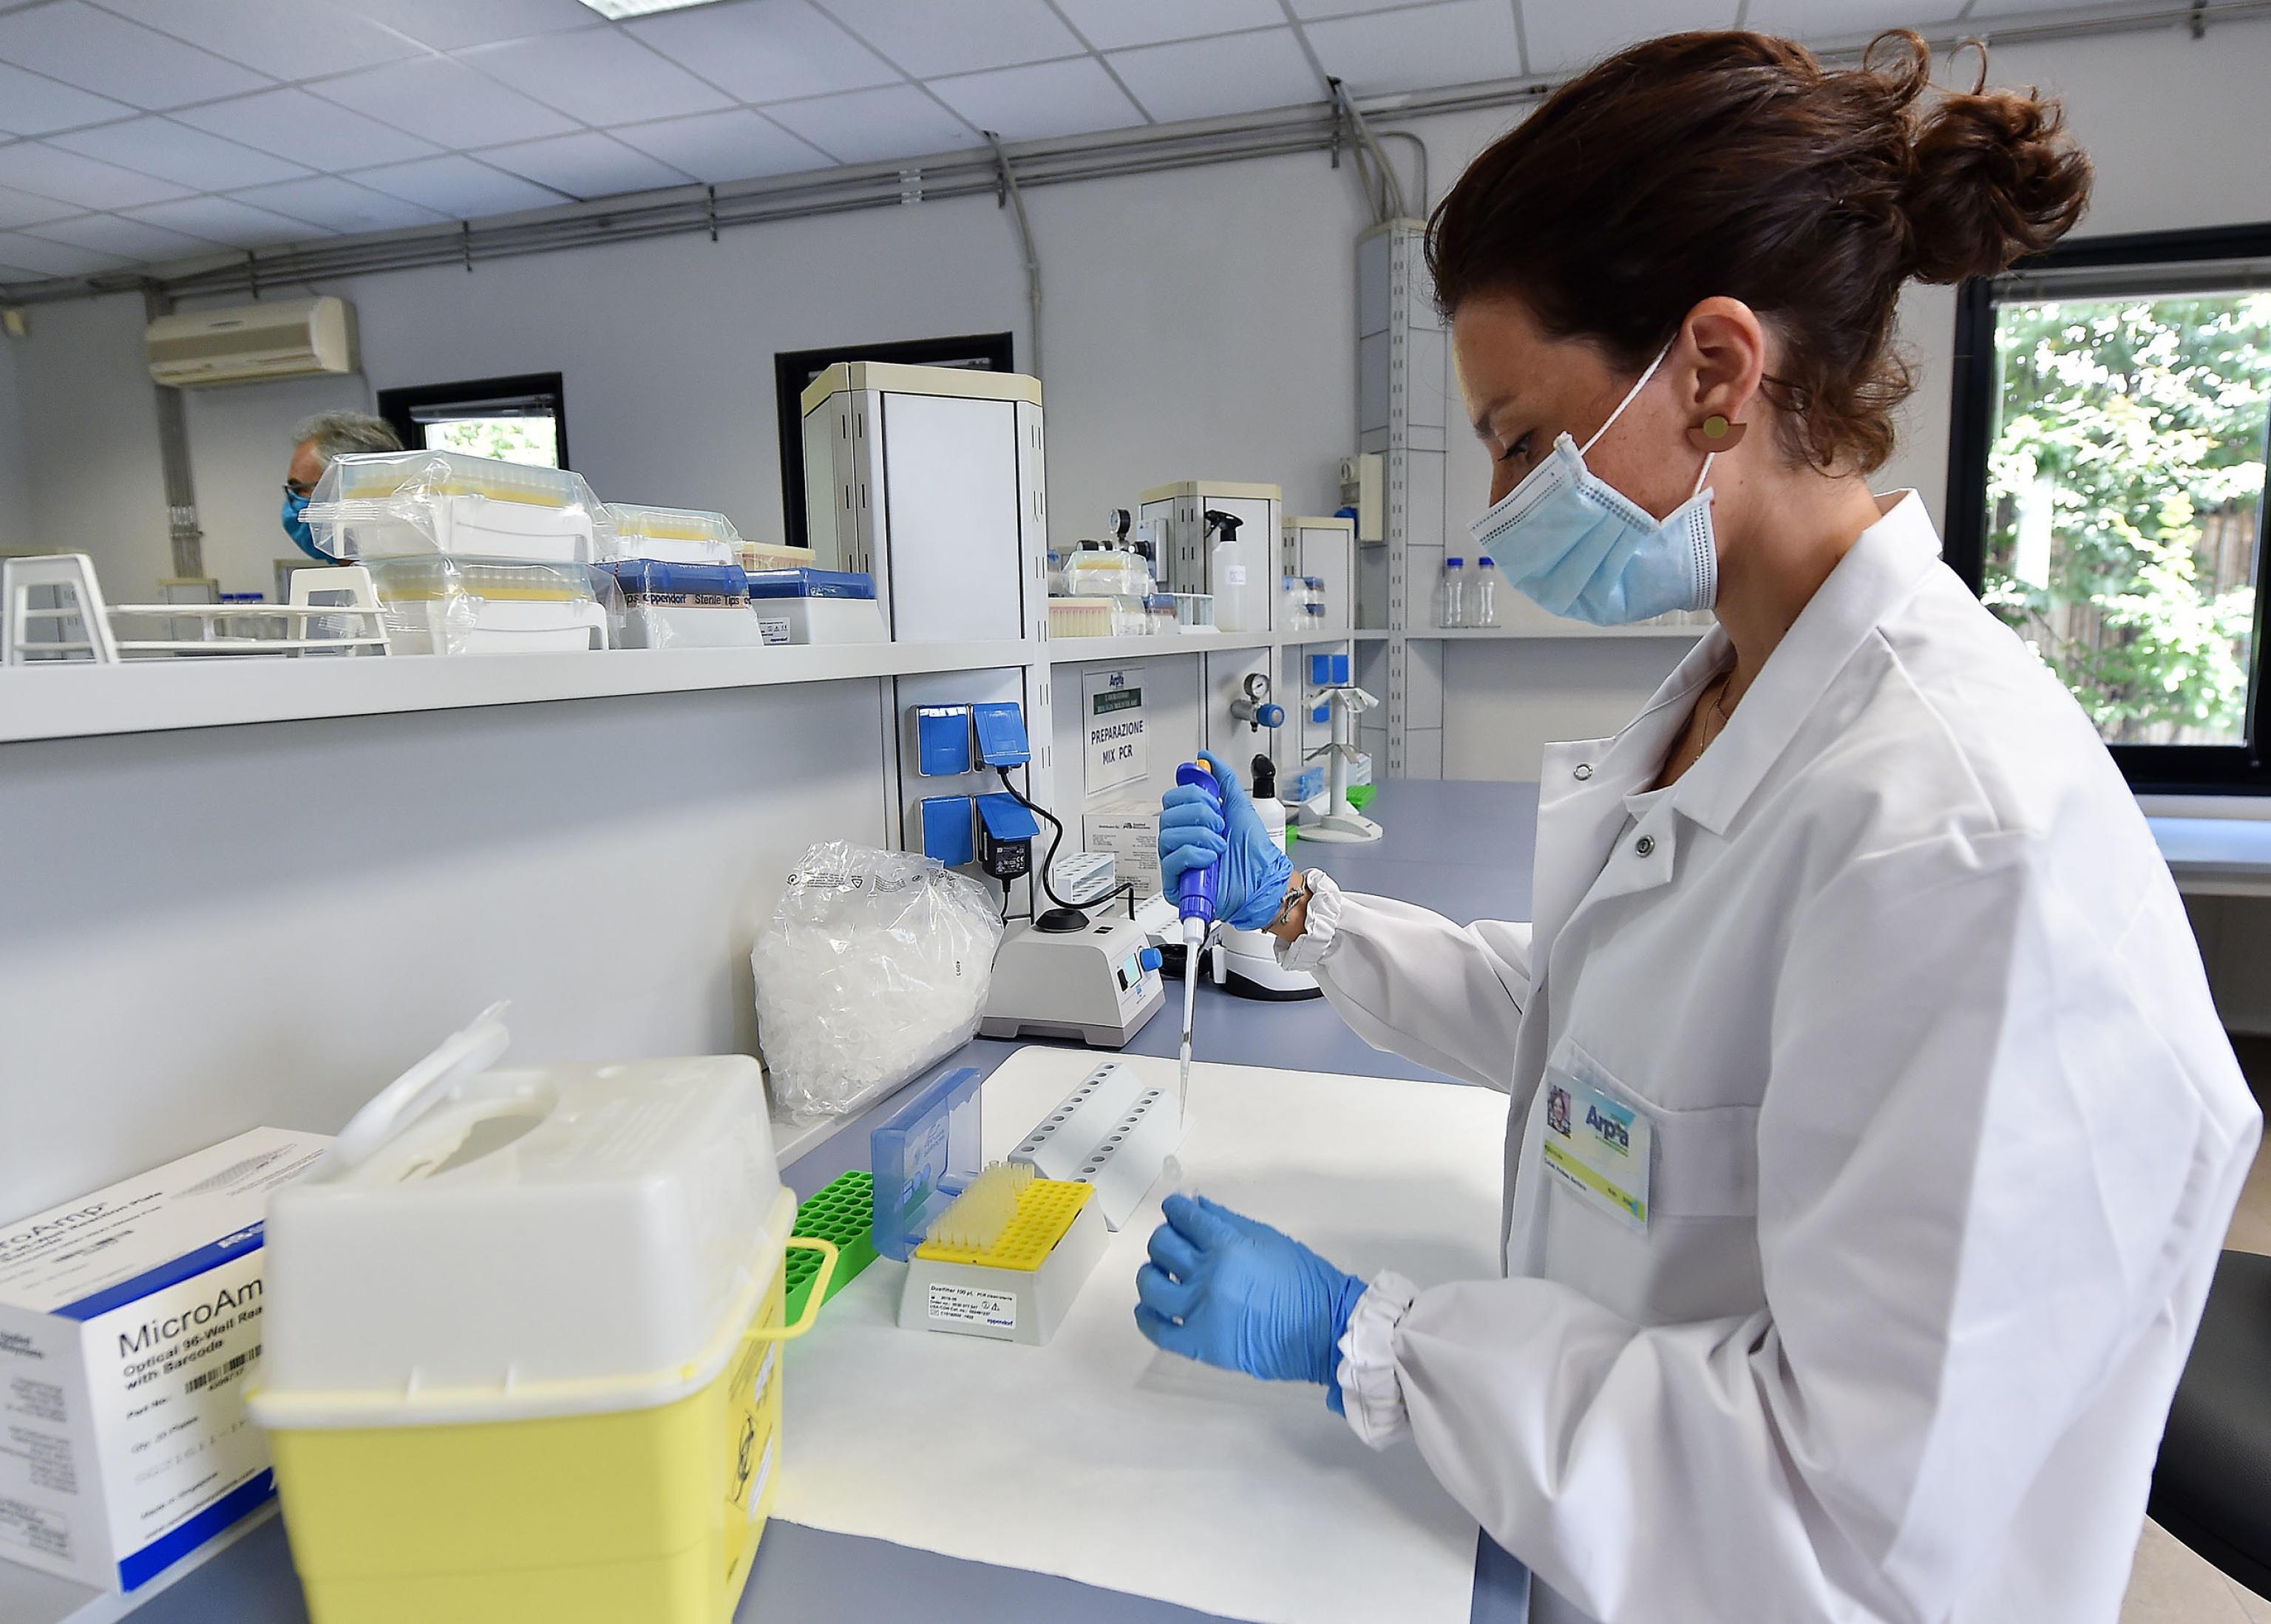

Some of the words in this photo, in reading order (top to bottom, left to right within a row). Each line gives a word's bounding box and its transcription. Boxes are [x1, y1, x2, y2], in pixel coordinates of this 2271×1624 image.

[642, 592, 687, 605] eppendorf
[695, 594, 722, 605] Sterile
[724, 595, 739, 607] Tips
[1091, 720, 1144, 745] PREPARAZIONE
[1102, 749, 1116, 765] MIX
[1119, 744, 1133, 760] PCR
[120, 1279, 263, 1359] MicroAm
[123, 1346, 178, 1376] Optical
[238, 1306, 262, 1324] Rea
[126, 1370, 158, 1390] with
[163, 1339, 223, 1375] Barcode
